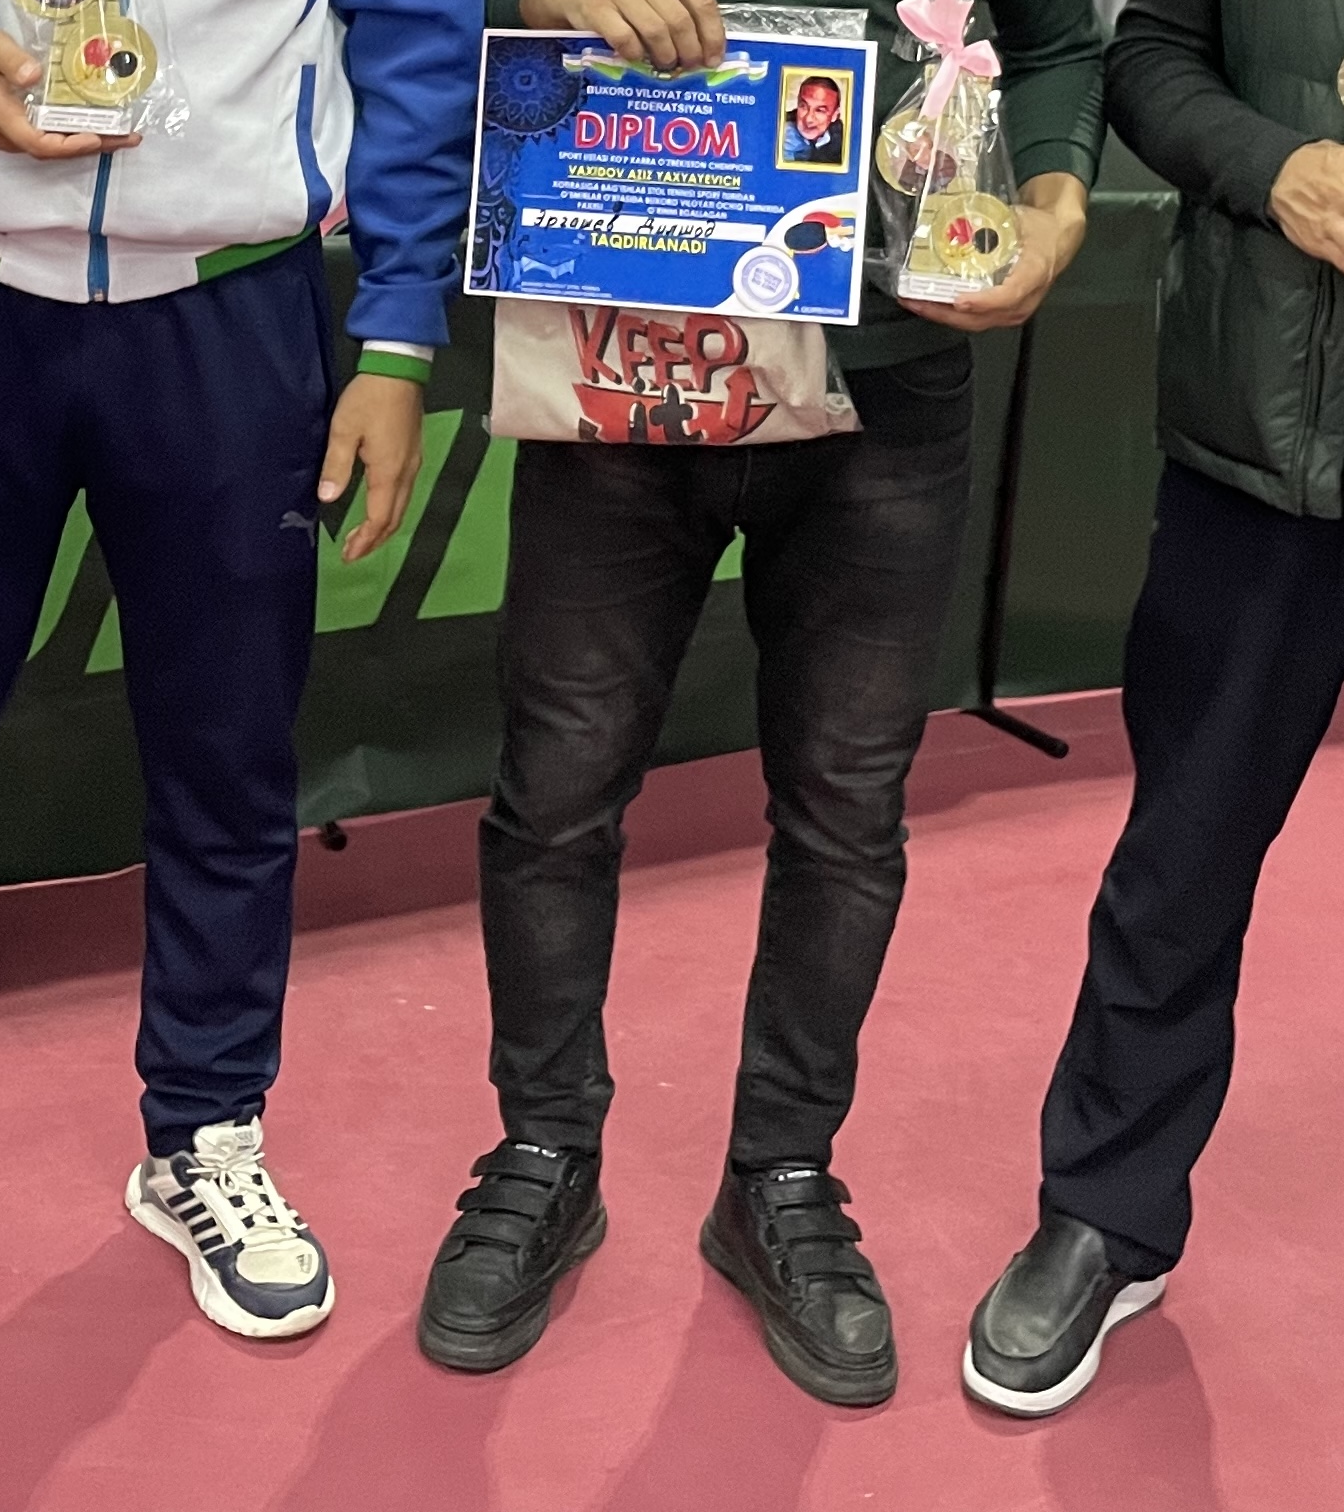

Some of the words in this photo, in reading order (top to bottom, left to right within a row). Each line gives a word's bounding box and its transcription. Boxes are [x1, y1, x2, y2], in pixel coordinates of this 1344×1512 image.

[586, 85, 634, 97] BUXORO
[635, 87, 681, 100] VILOYAT
[683, 90, 713, 103] STOL
[715, 93, 757, 105] TENNIS
[627, 100, 713, 114] FEDERATSIYASI
[574, 111, 740, 159] DIPLOM
[568, 164, 625, 178] VAXIDOV
[627, 168, 654, 181] AZIZ
[656, 170, 742, 187] YAXYAYEVICH
[590, 232, 707, 255] TAQDIRLANADI
[568, 303, 750, 395] KEEP
